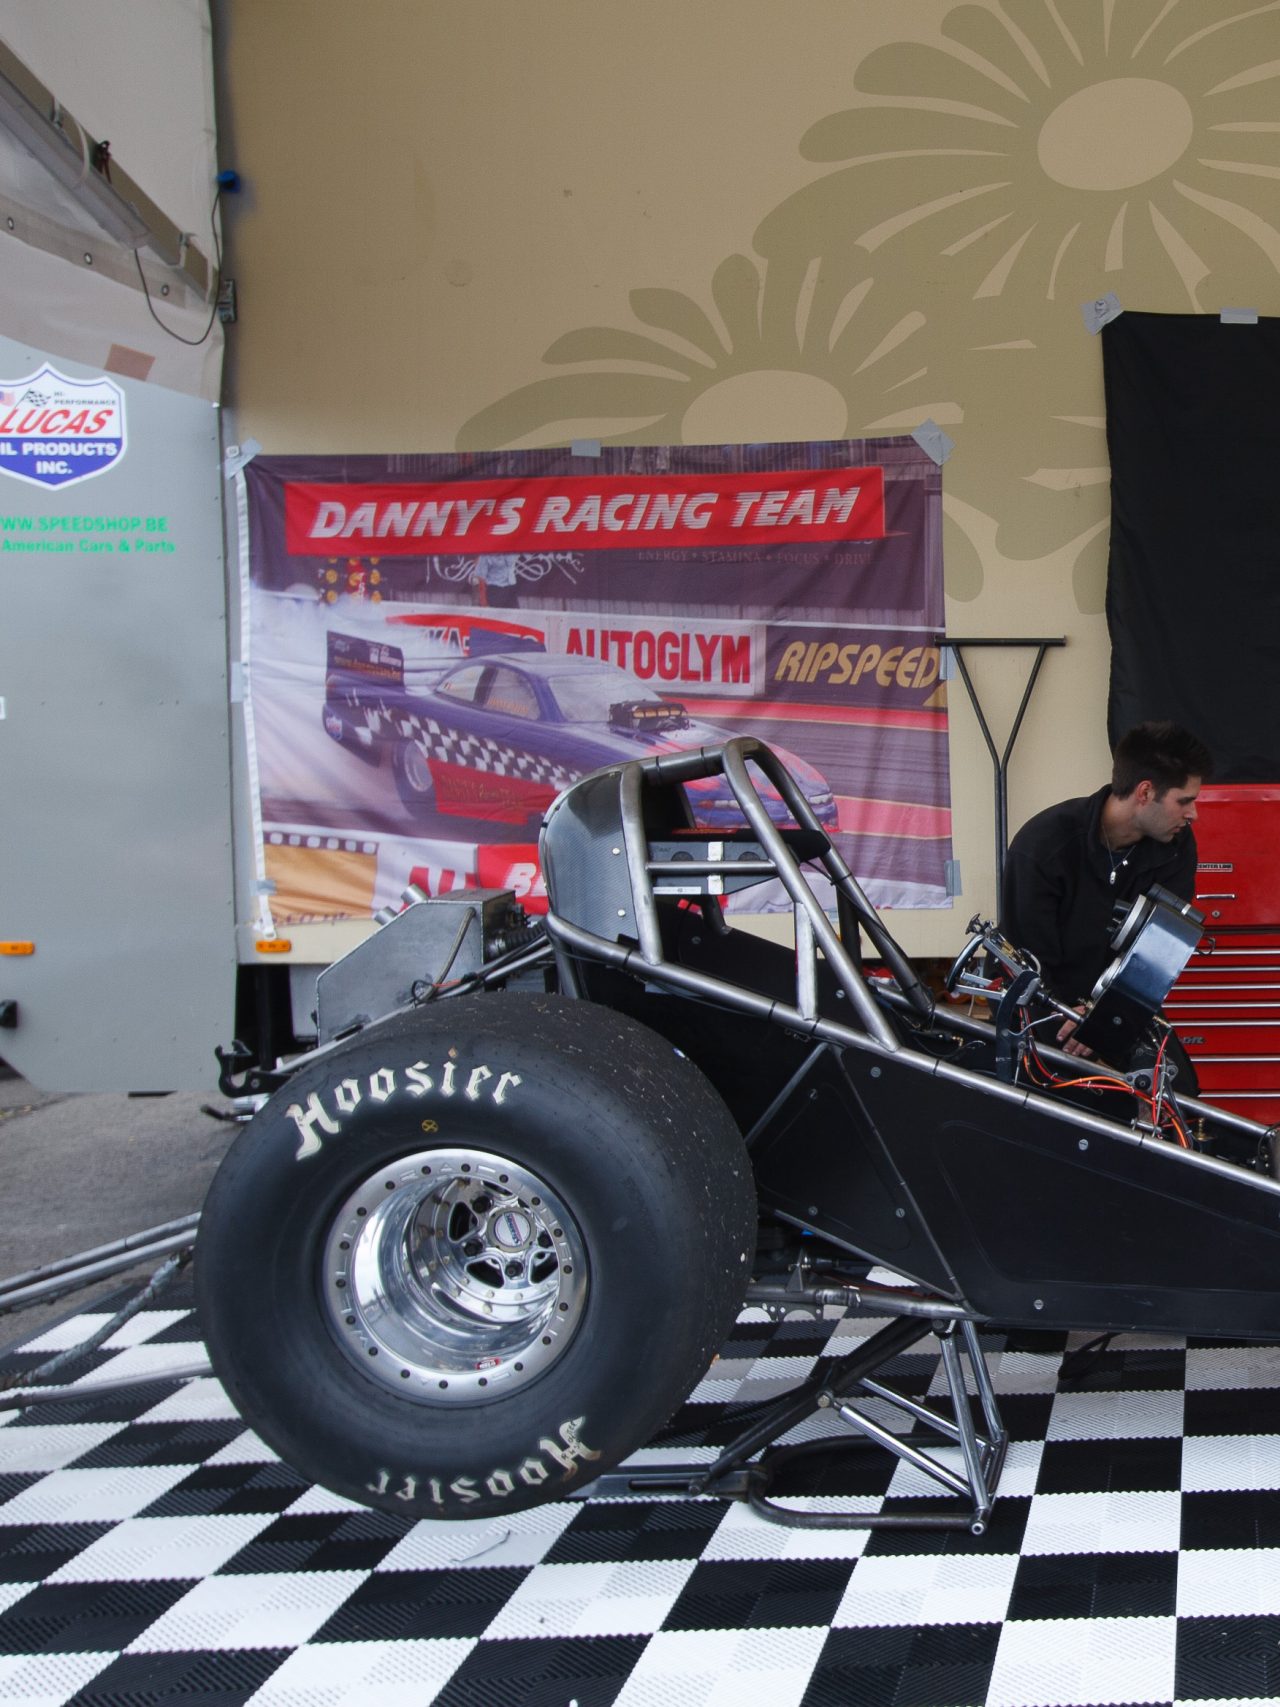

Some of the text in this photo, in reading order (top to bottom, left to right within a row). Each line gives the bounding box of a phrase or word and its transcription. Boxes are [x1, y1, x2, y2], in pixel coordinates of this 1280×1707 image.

[0, 409, 114, 434] LUCAS
[0, 442, 118, 456] IL PRODUCTS
[36, 461, 73, 474] INC.
[309, 487, 861, 538] DANNY'S RACING TEAM
[2, 539, 176, 553] American Cars & Parts
[566, 628, 751, 684] AUTOGLYM
[775, 641, 941, 689] RIPSPEED
[285, 1057, 521, 1161] Hoosier
[366, 1415, 602, 1504] Hoosier
